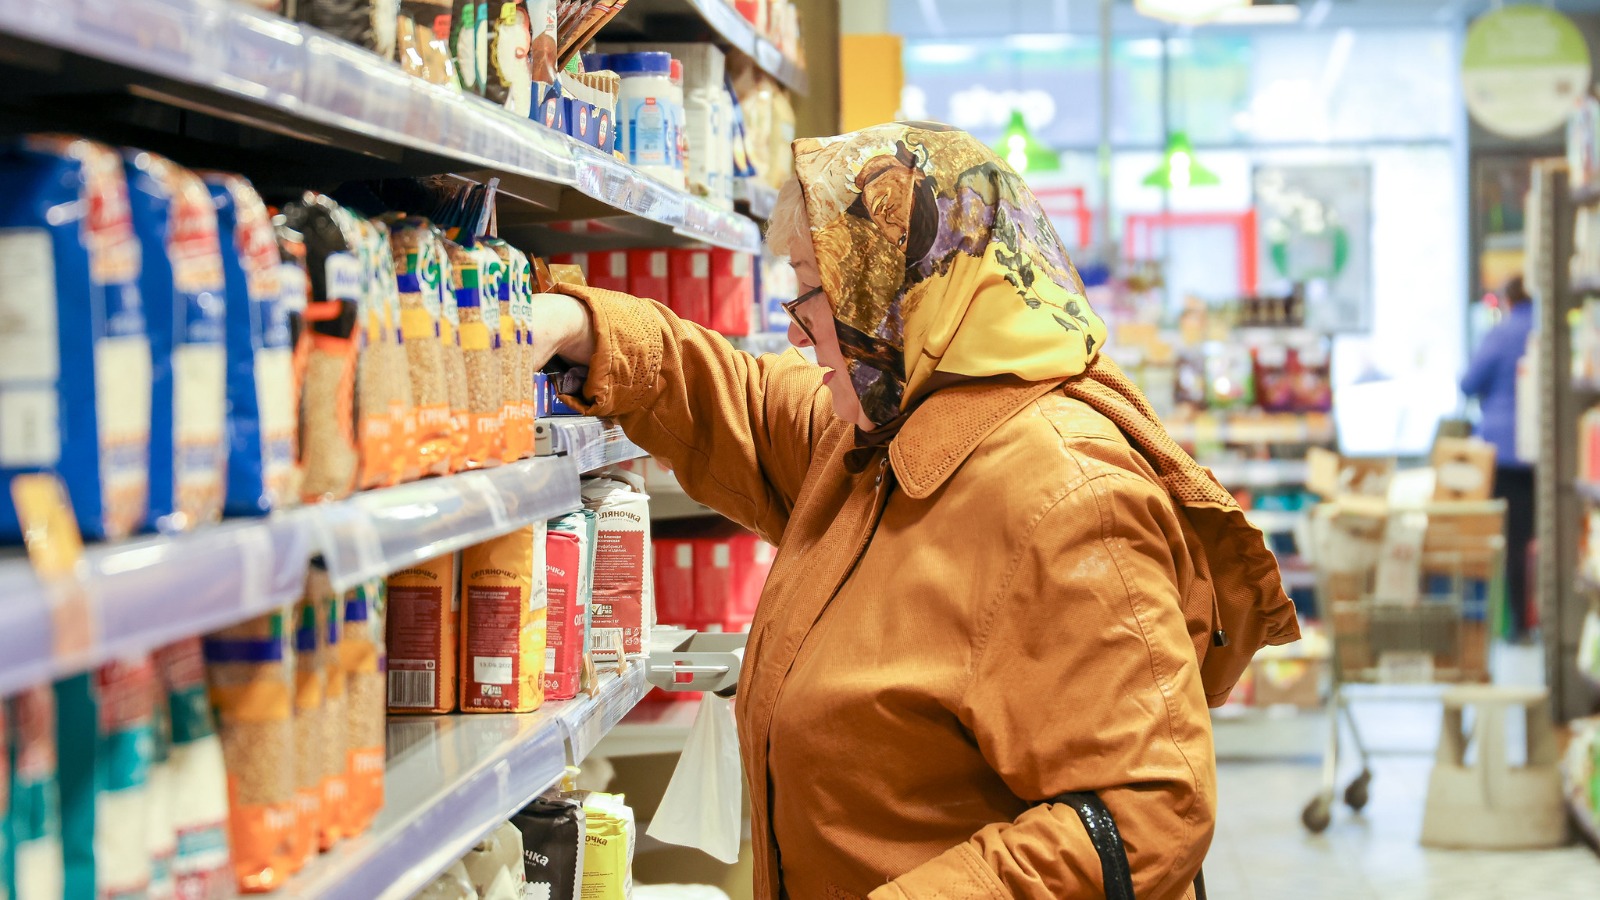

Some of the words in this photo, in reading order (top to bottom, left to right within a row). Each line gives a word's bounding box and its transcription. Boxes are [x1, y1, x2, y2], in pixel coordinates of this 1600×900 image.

[546, 564, 566, 577] очка
[585, 835, 608, 846] очка
[523, 849, 550, 867] чка
